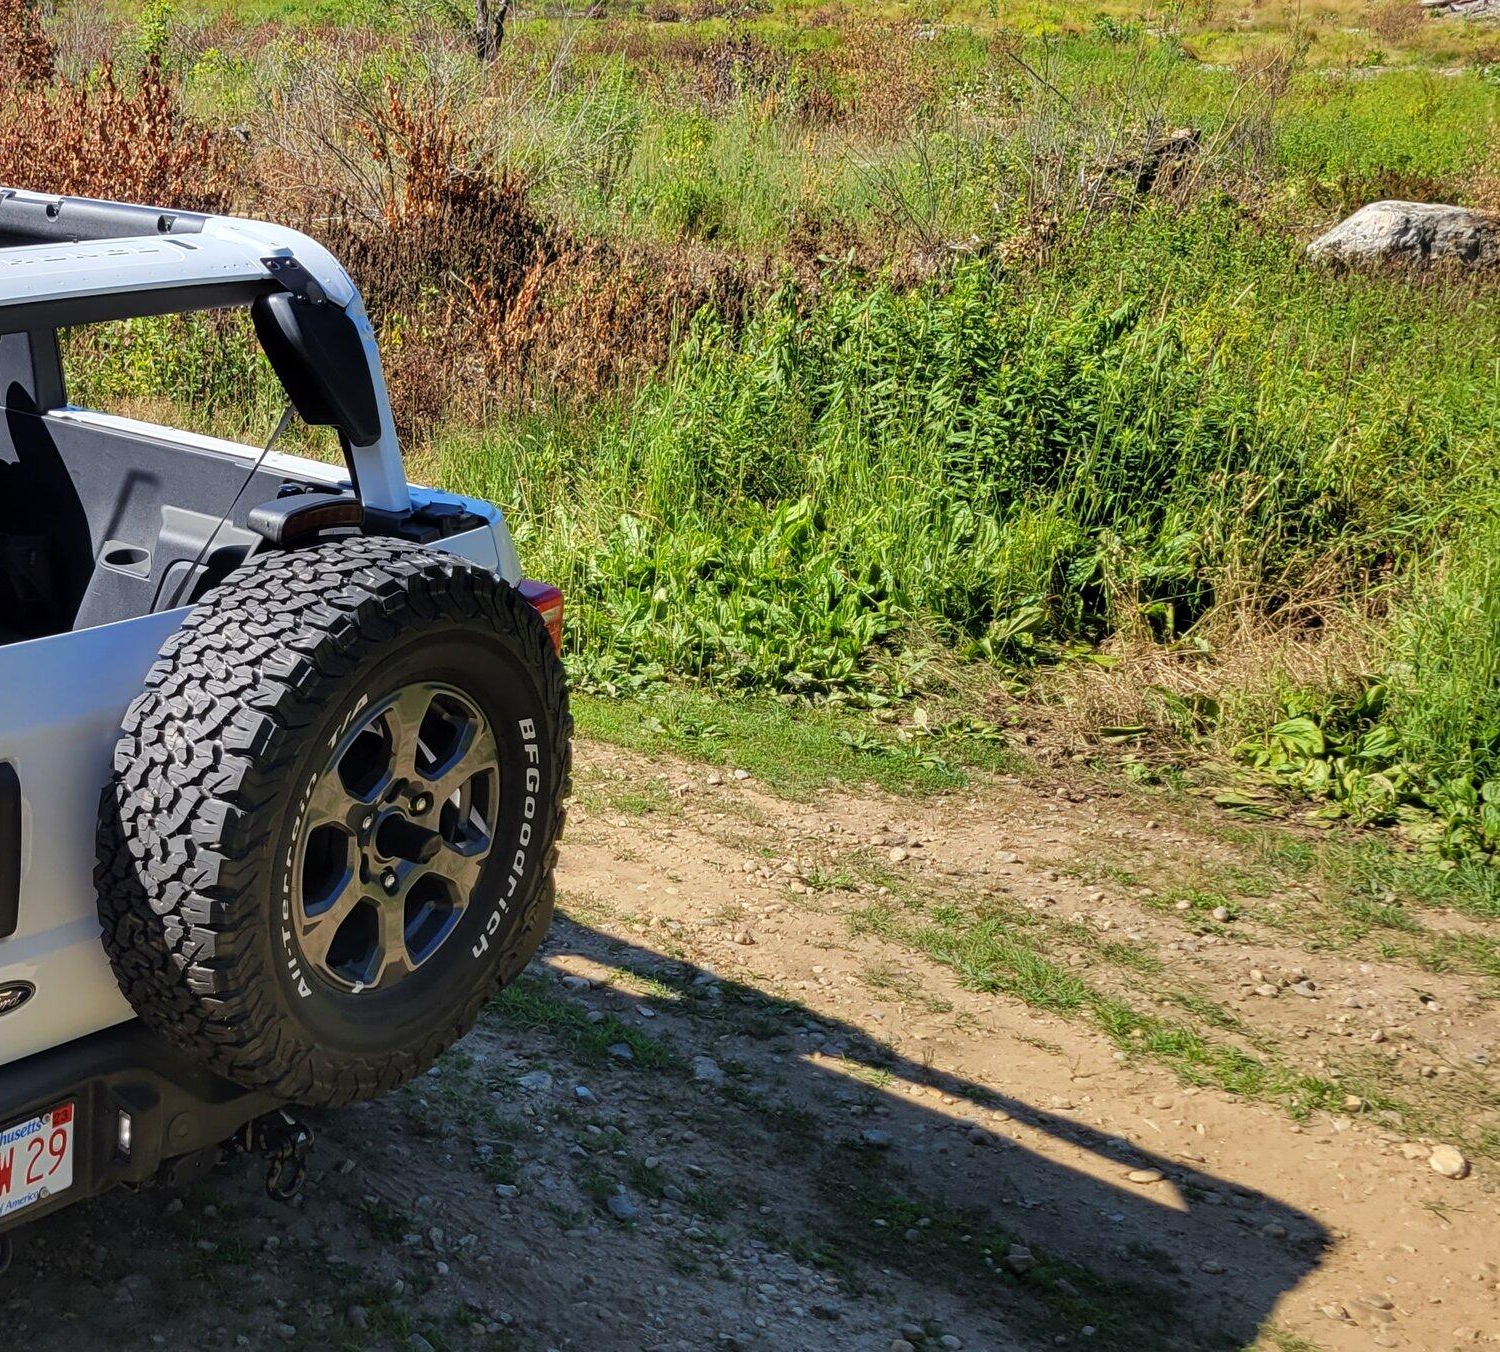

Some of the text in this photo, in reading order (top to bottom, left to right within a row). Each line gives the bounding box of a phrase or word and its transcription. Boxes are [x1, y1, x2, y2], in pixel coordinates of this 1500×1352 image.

[281, 692, 369, 998] All-Terrain T/A
[471, 717, 540, 959] BFGoodrich
[5, 1190, 40, 1210] America
[26, 1127, 68, 1185] 29
